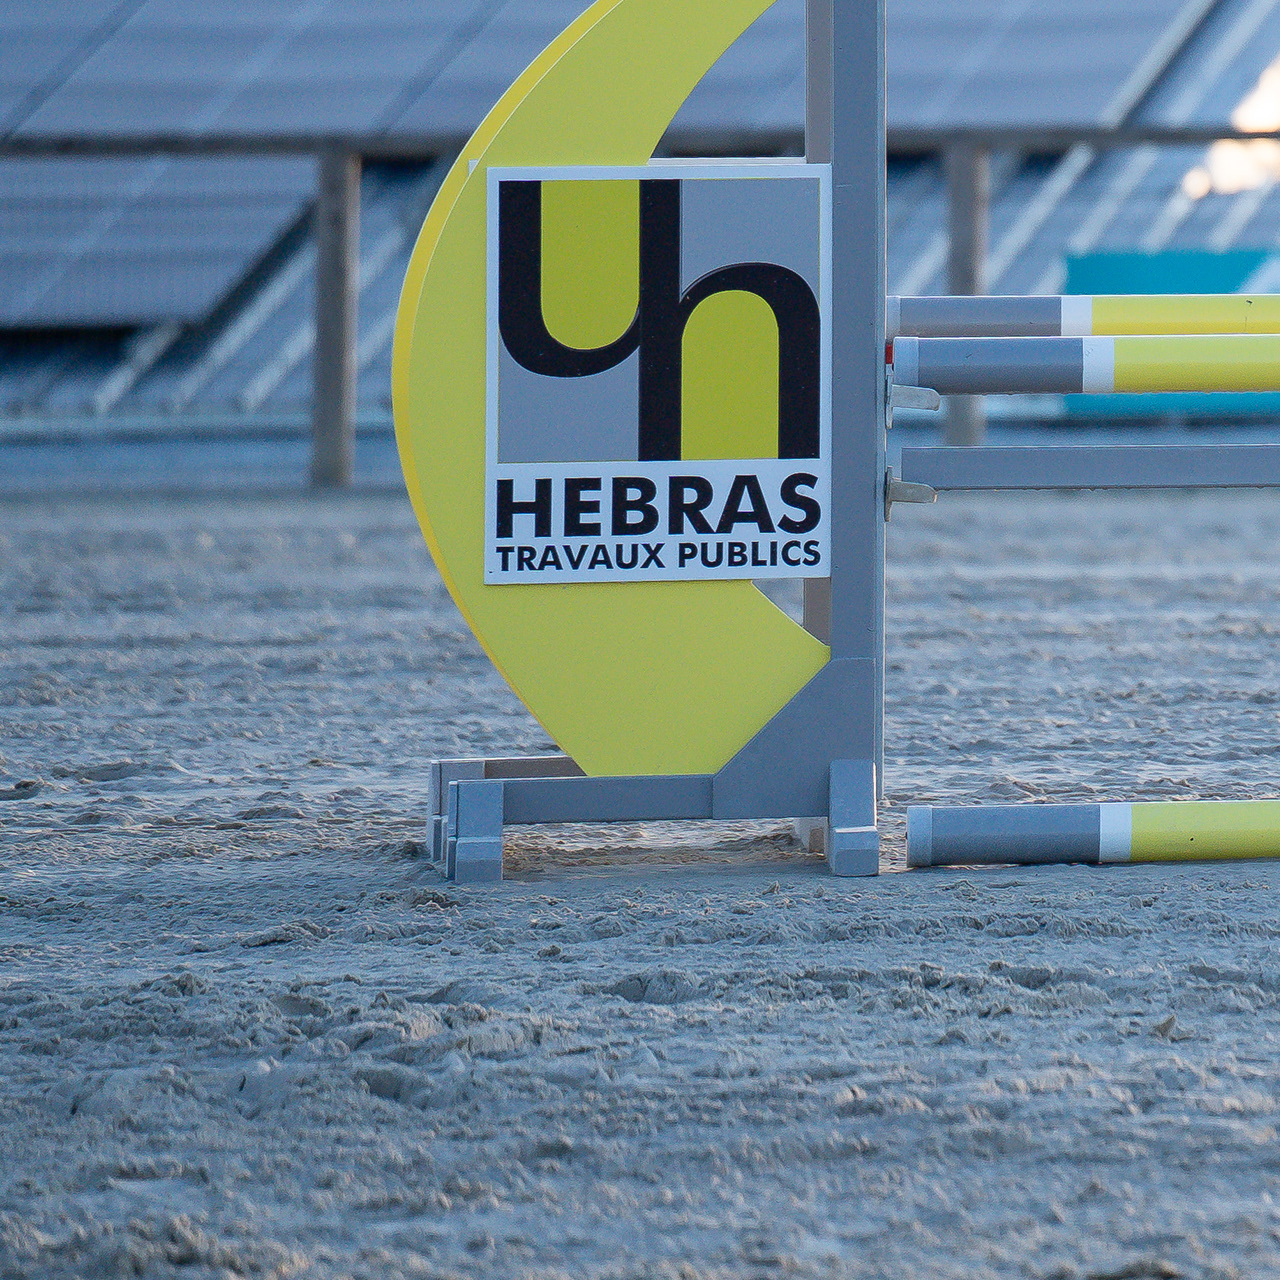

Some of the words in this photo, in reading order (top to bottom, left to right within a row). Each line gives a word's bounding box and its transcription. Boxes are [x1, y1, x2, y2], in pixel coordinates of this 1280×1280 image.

[496, 473, 820, 538] HEBRAS
[496, 544, 665, 572] TRAVAUX
[678, 540, 821, 568] PUBLICS
